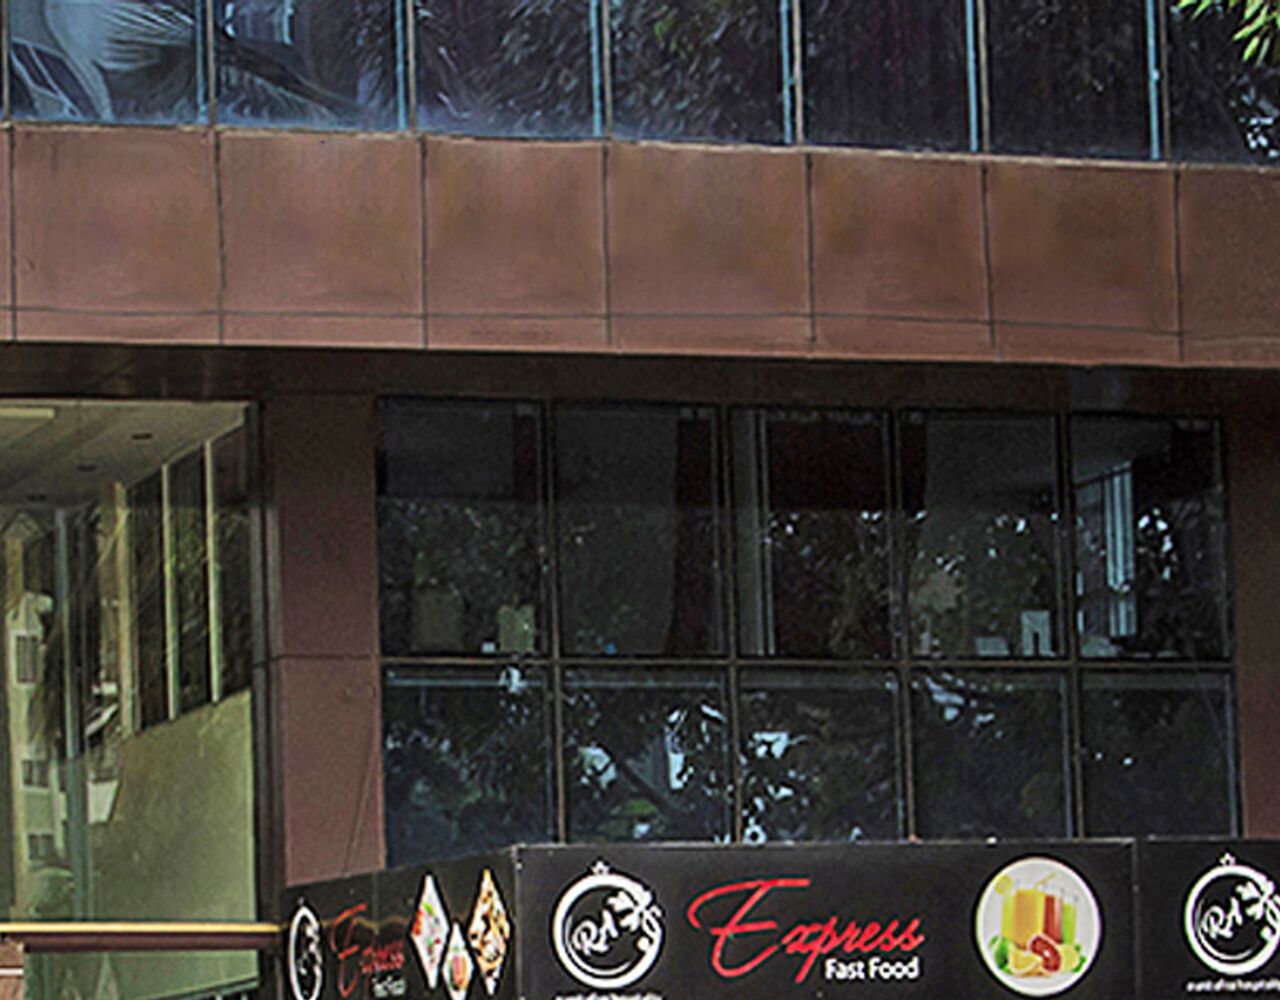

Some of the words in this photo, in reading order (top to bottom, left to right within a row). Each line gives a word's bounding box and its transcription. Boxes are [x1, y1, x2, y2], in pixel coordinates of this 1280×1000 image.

[687, 878, 925, 983] Express
[824, 957, 866, 979] Fast
[869, 956, 920, 979] Food
